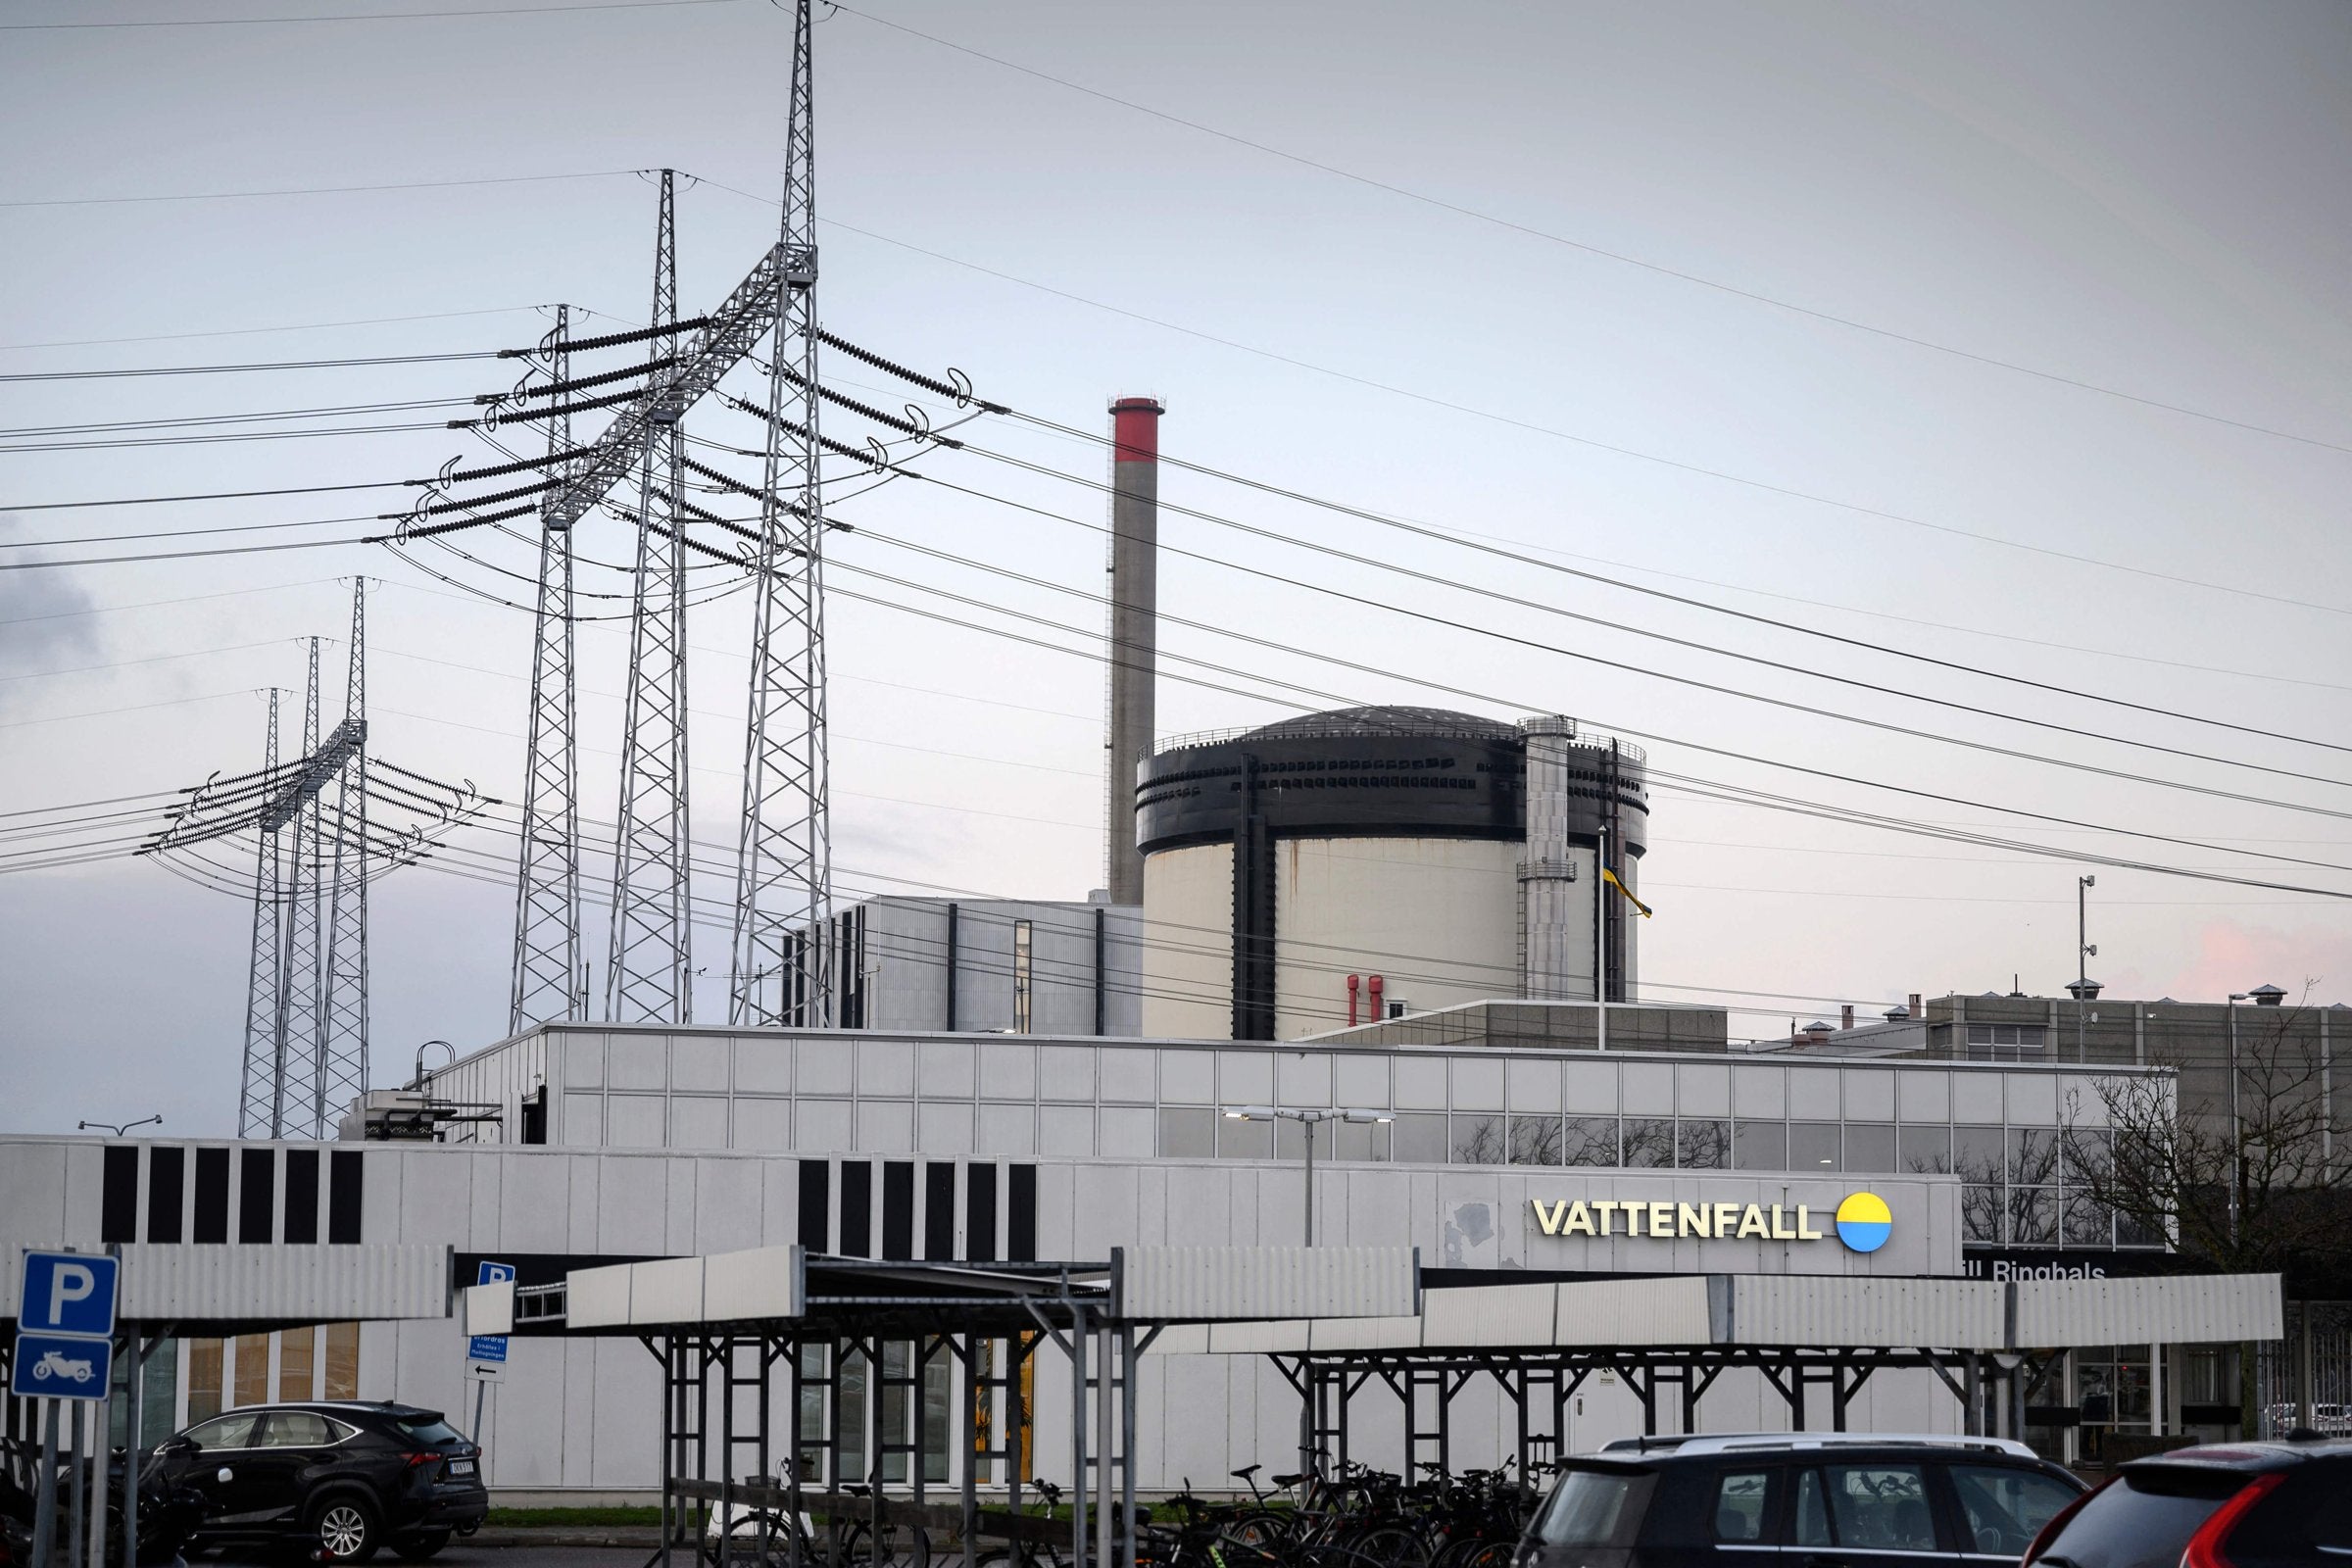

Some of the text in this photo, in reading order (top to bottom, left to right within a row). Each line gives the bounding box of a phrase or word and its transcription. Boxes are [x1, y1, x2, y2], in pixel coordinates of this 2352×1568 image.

[1531, 1200, 1823, 1241] VATTENFALL
[489, 1266, 507, 1285] P
[1962, 1260, 2106, 1282] ill Ringhals
[49, 1262, 95, 1325] P
